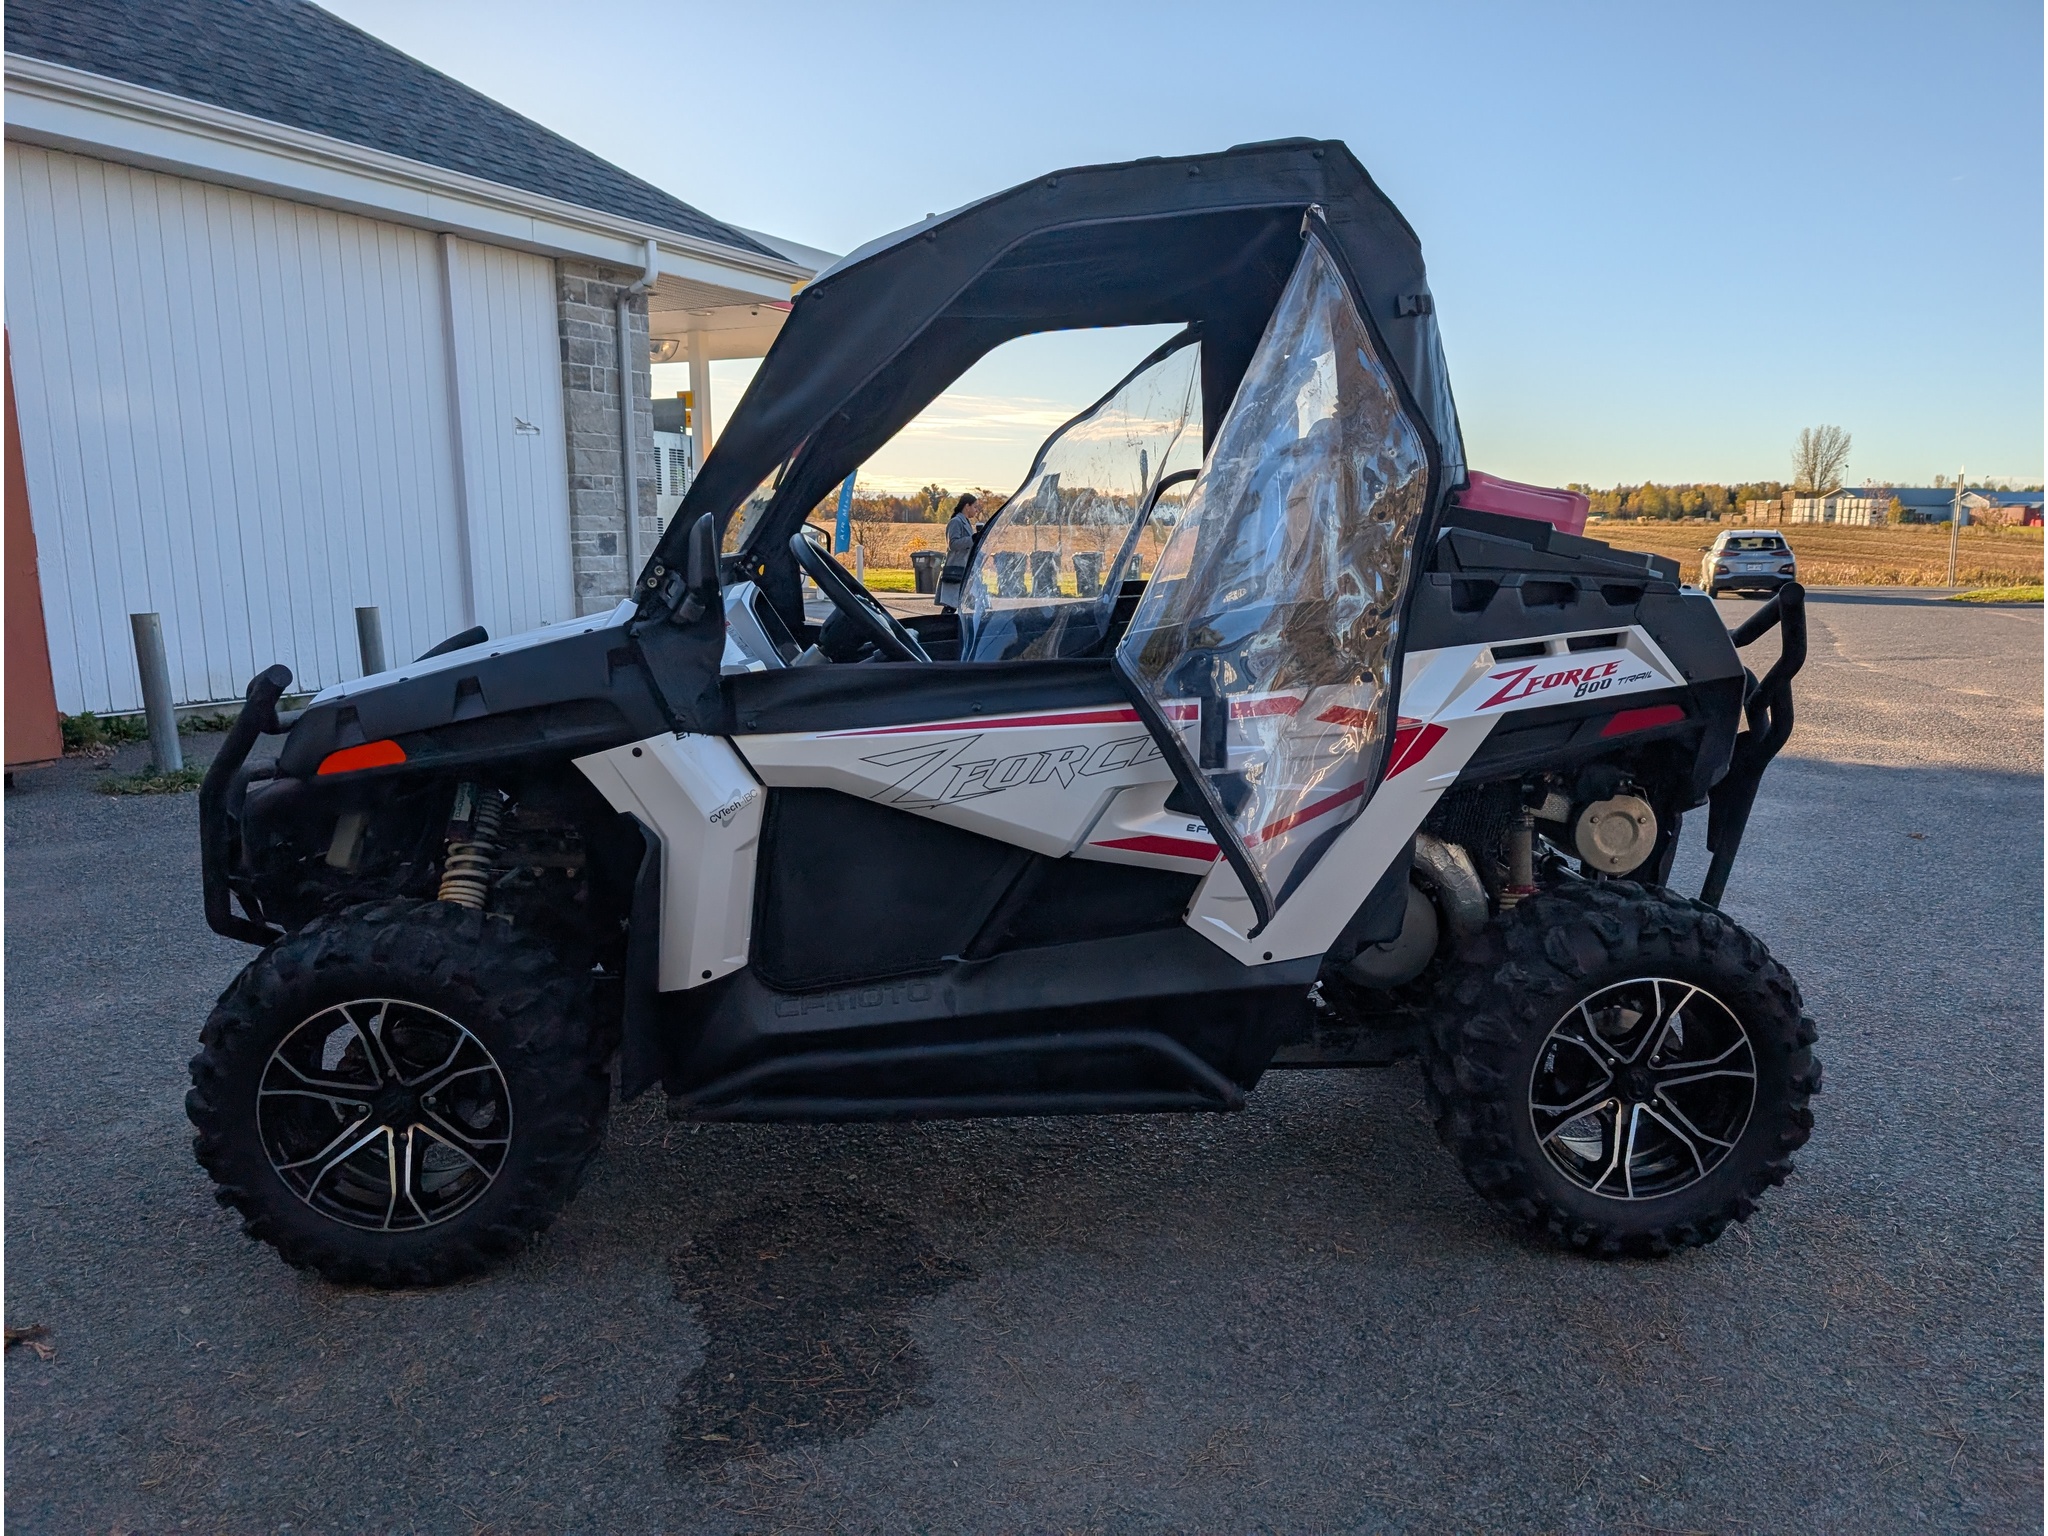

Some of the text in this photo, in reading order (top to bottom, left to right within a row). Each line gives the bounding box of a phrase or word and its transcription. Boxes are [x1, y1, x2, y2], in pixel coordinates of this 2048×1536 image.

[842, 484, 852, 517] MILES
[1474, 659, 1624, 712] ZFORCE
[1574, 670, 1653, 699] 800 TRAIL
[709, 788, 758, 824] CVTech-IBC
